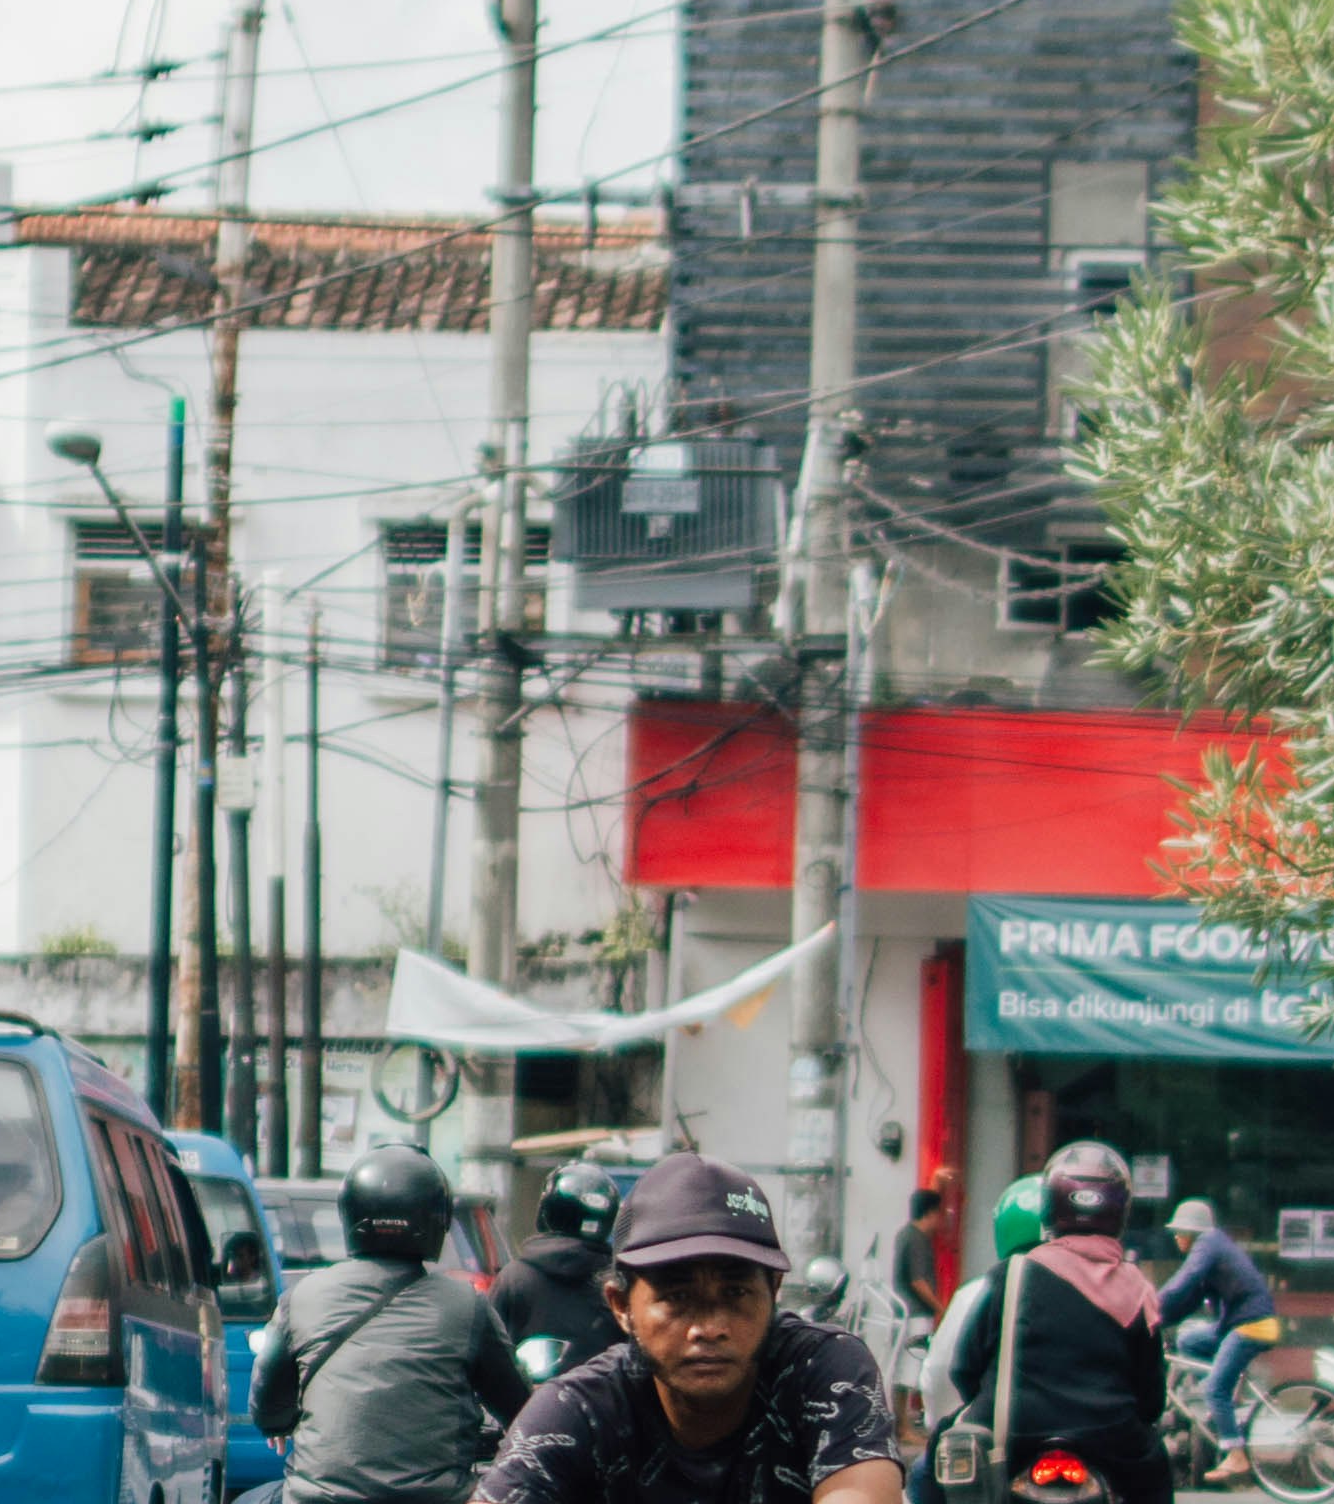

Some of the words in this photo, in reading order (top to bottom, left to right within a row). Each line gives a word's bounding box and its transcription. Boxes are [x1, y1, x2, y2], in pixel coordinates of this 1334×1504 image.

[999, 920, 1142, 959] PRIMA
[1149, 924, 1269, 961] FOOD
[998, 991, 1060, 1019] Bisa
[1067, 995, 1215, 1029] dikunjungi
[1223, 997, 1250, 1024] di
